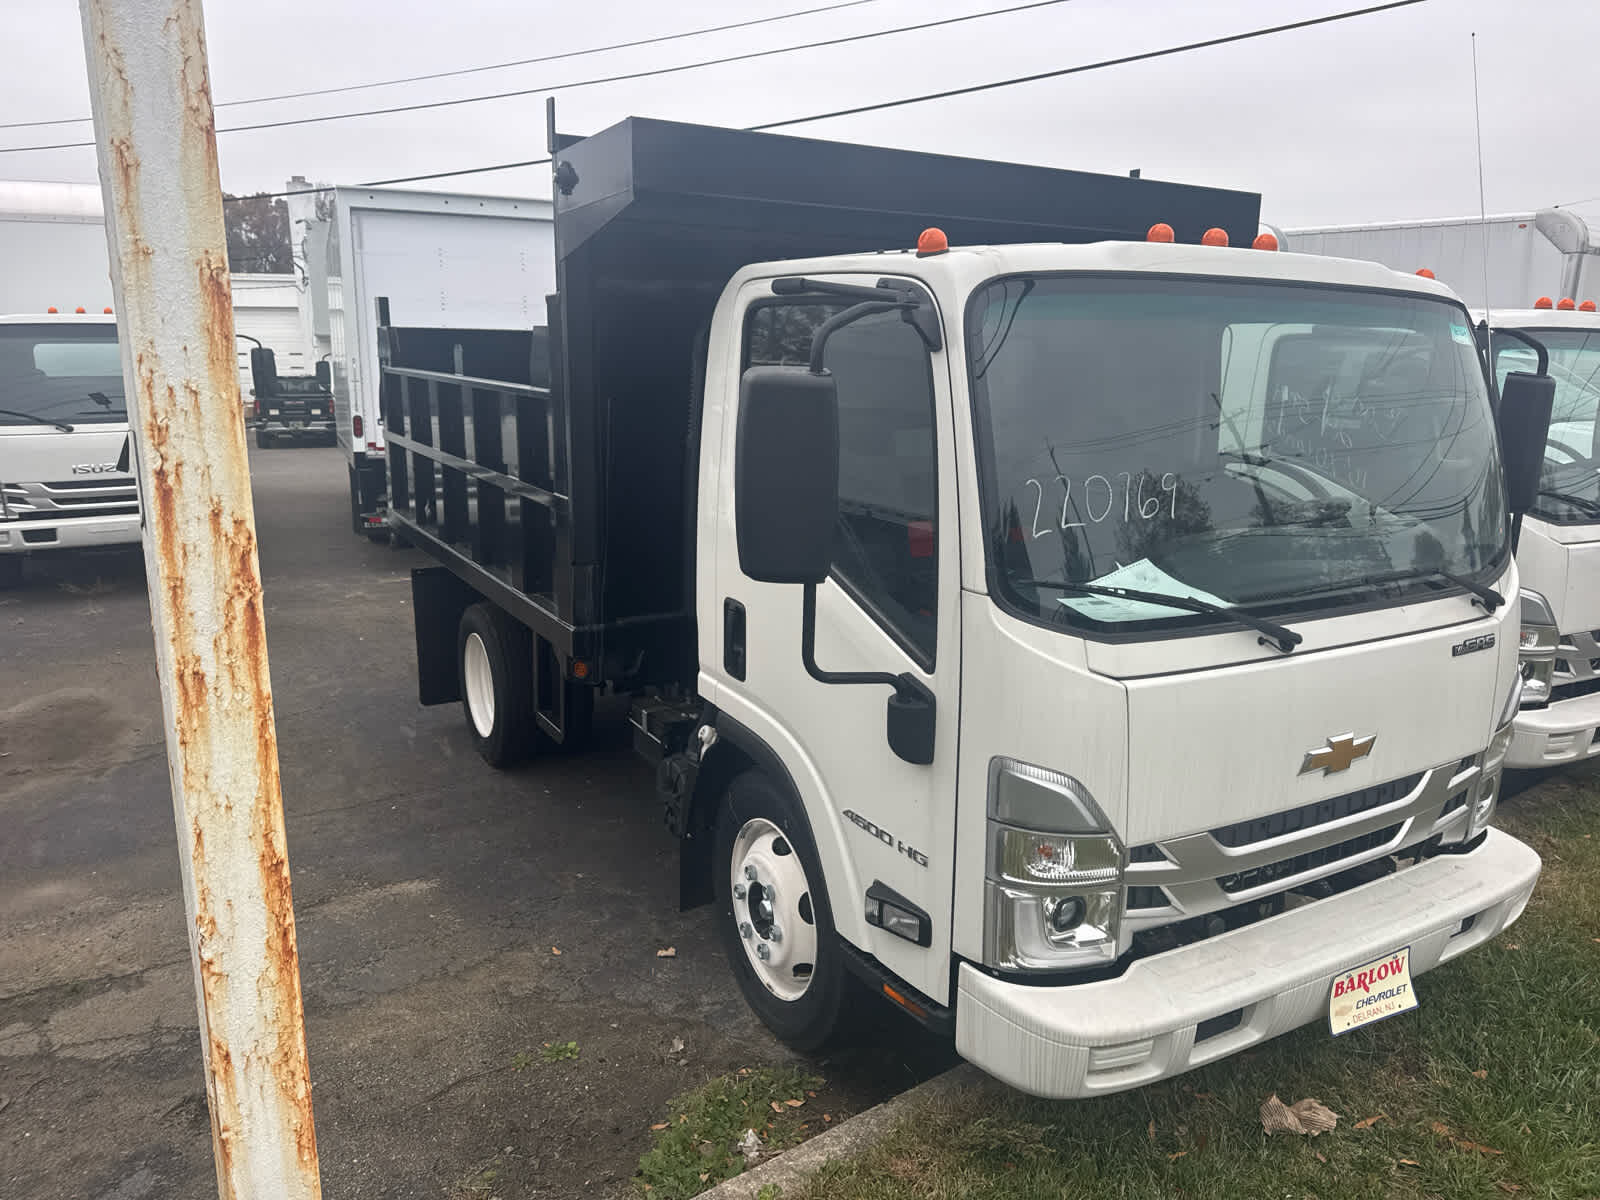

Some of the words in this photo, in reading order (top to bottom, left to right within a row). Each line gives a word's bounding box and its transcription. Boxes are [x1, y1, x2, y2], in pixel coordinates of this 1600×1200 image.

[72, 463, 117, 474] ISUZ
[1026, 472, 1176, 538] 220769
[843, 809, 894, 847] 4500
[898, 840, 929, 868] HG
[1333, 957, 1405, 998] BARLOW
[1356, 984, 1407, 1009] CHEVROLET
